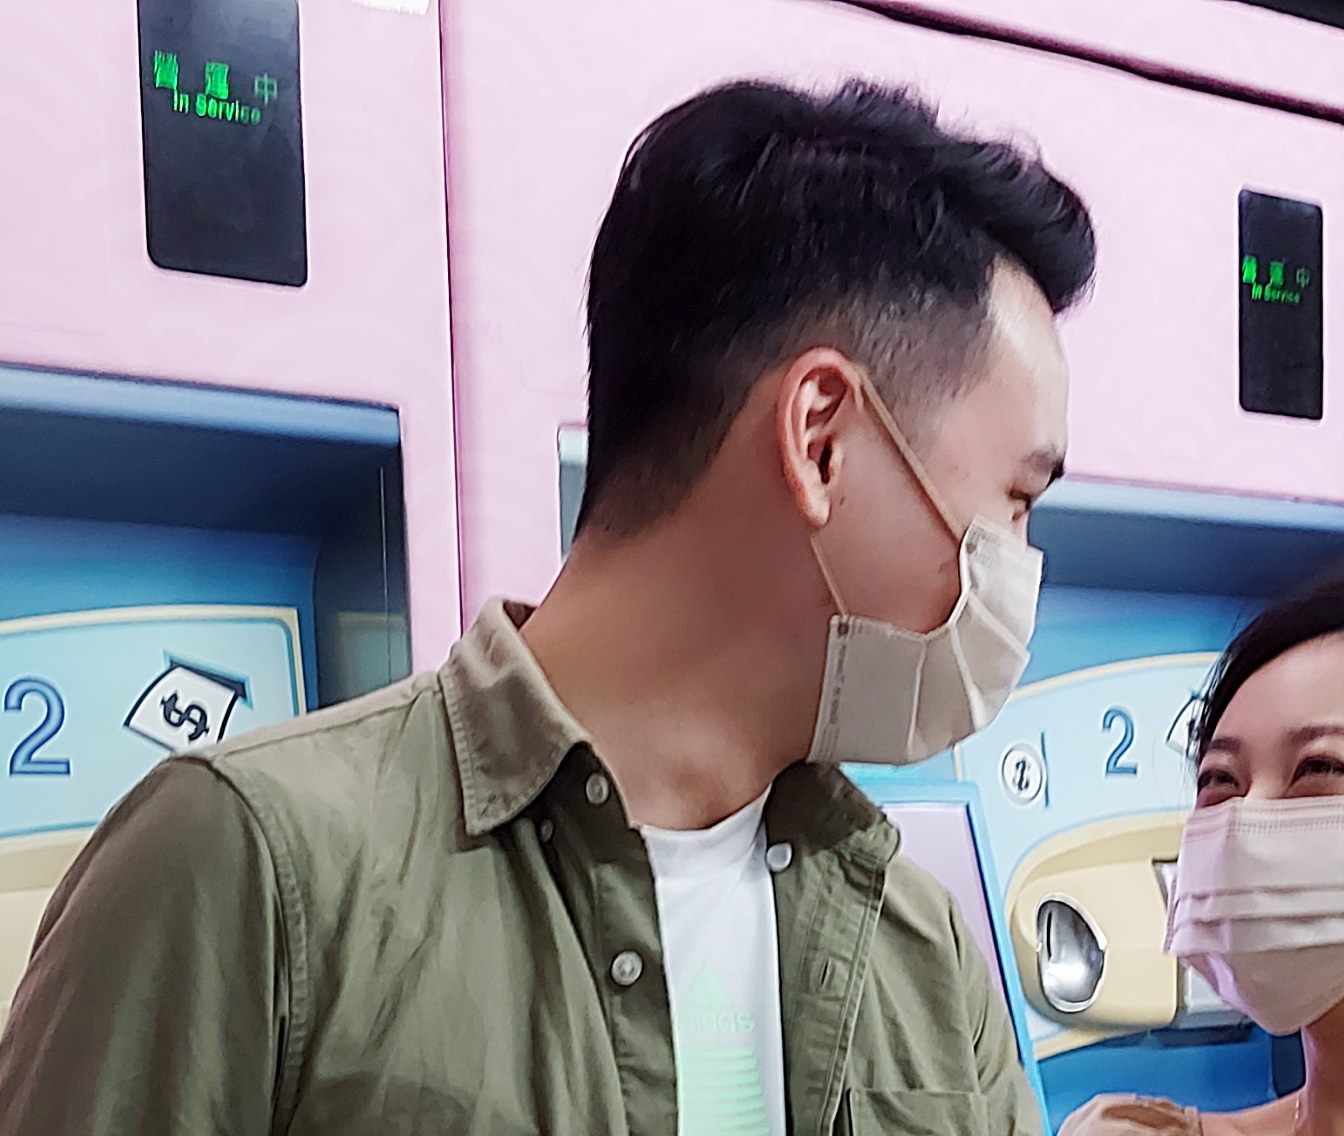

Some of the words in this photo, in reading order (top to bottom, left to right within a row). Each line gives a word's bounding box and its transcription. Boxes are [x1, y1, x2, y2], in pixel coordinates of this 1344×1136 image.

[173, 90, 190, 113] In
[196, 93, 261, 125] Service
[3, 675, 71, 777] 2
[1102, 707, 1138, 776] 2
